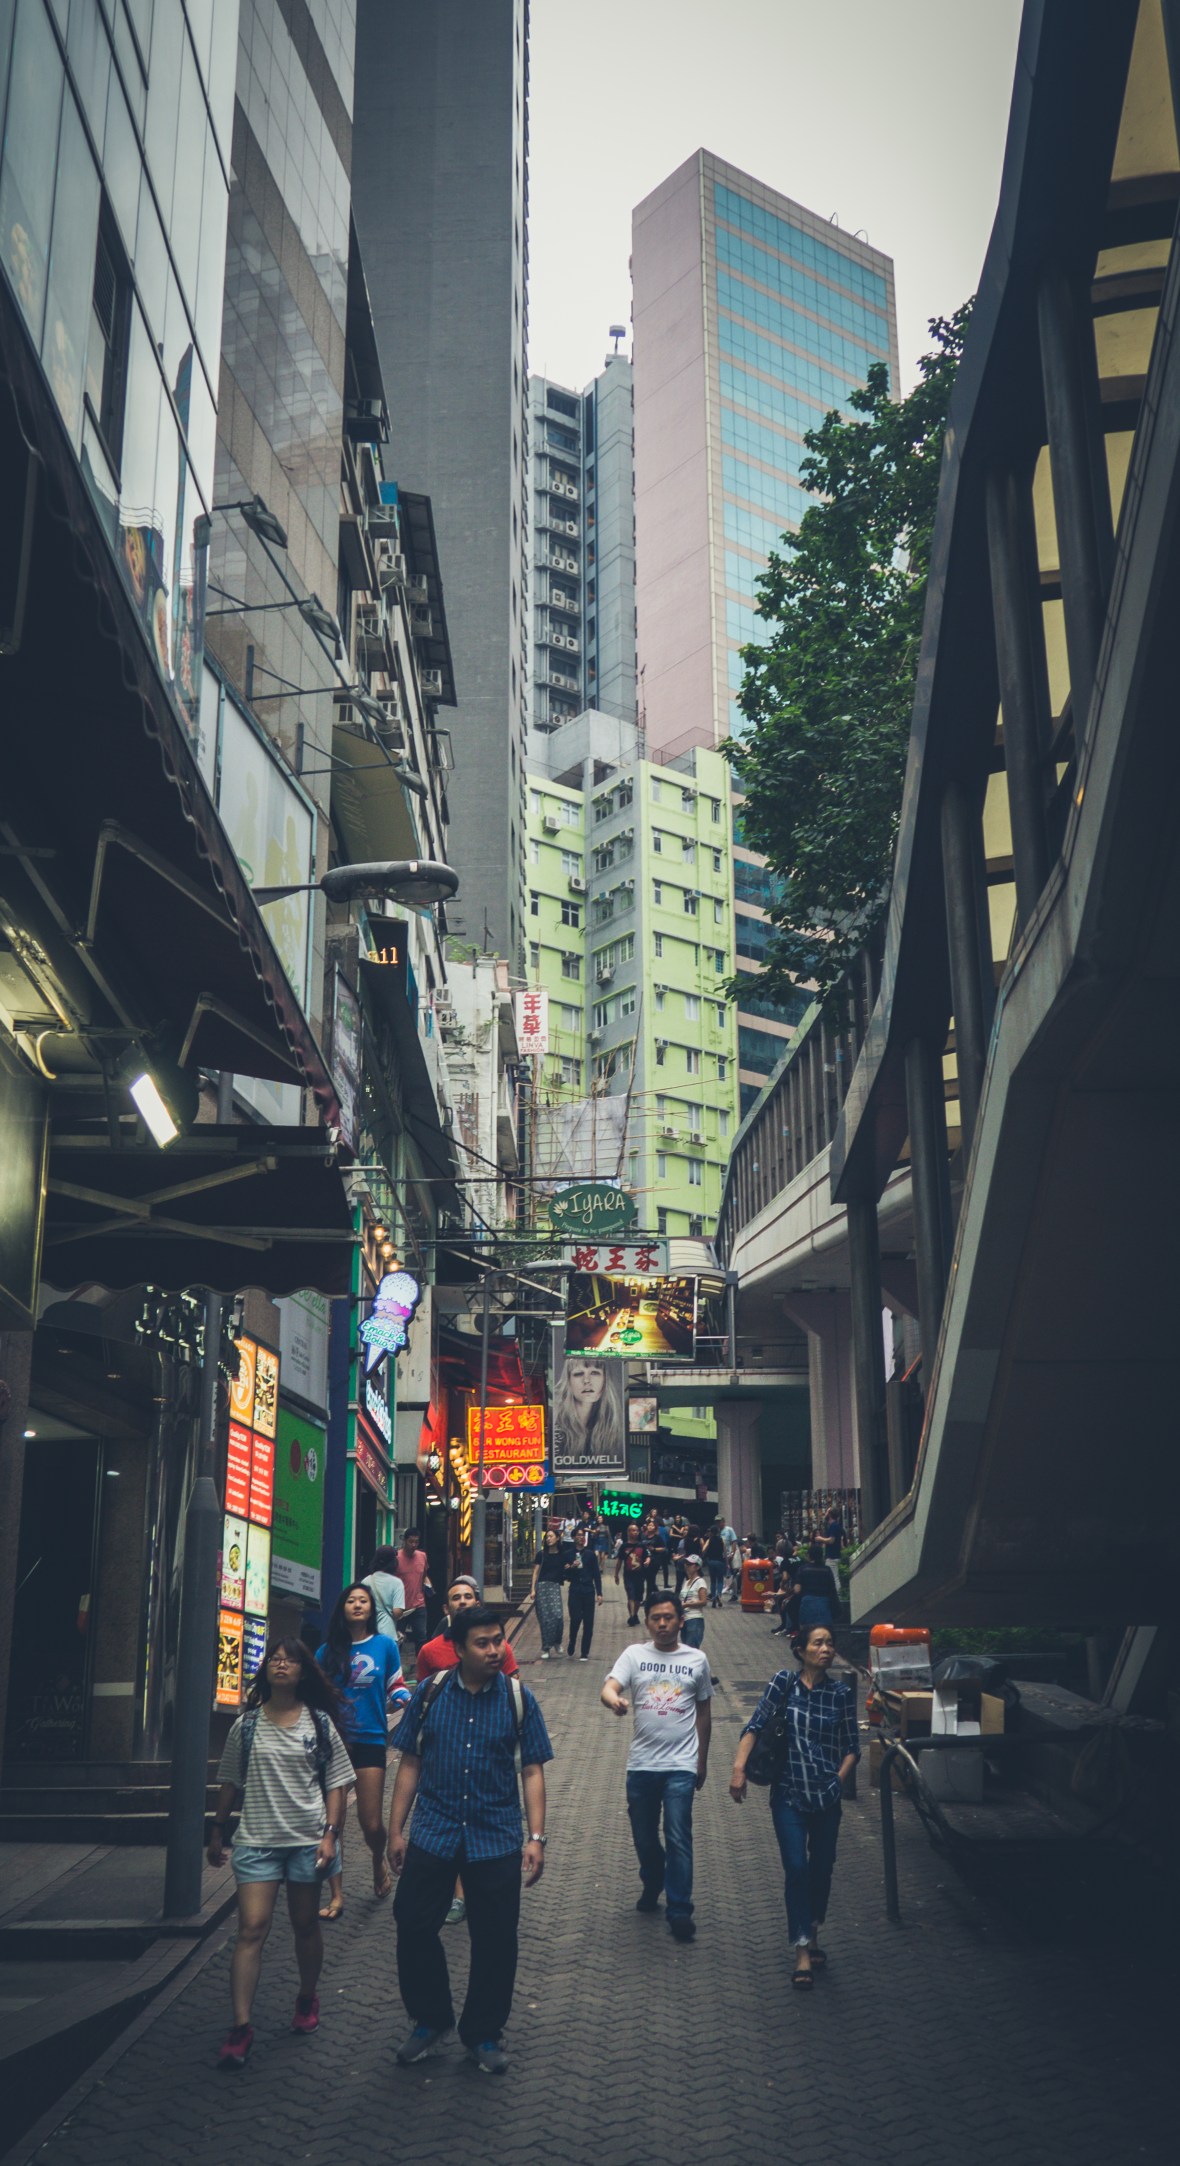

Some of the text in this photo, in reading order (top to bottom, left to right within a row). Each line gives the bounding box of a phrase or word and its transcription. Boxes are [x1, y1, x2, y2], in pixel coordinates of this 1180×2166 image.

[571, 1246, 659, 1272] 蛇王芬
[362, 1320, 406, 1346] Emack &
[473, 1436, 541, 1446] SR WONG FUN
[554, 1455, 622, 1465] GOLDWELL
[640, 1661, 694, 1678] GOOD LUCK
